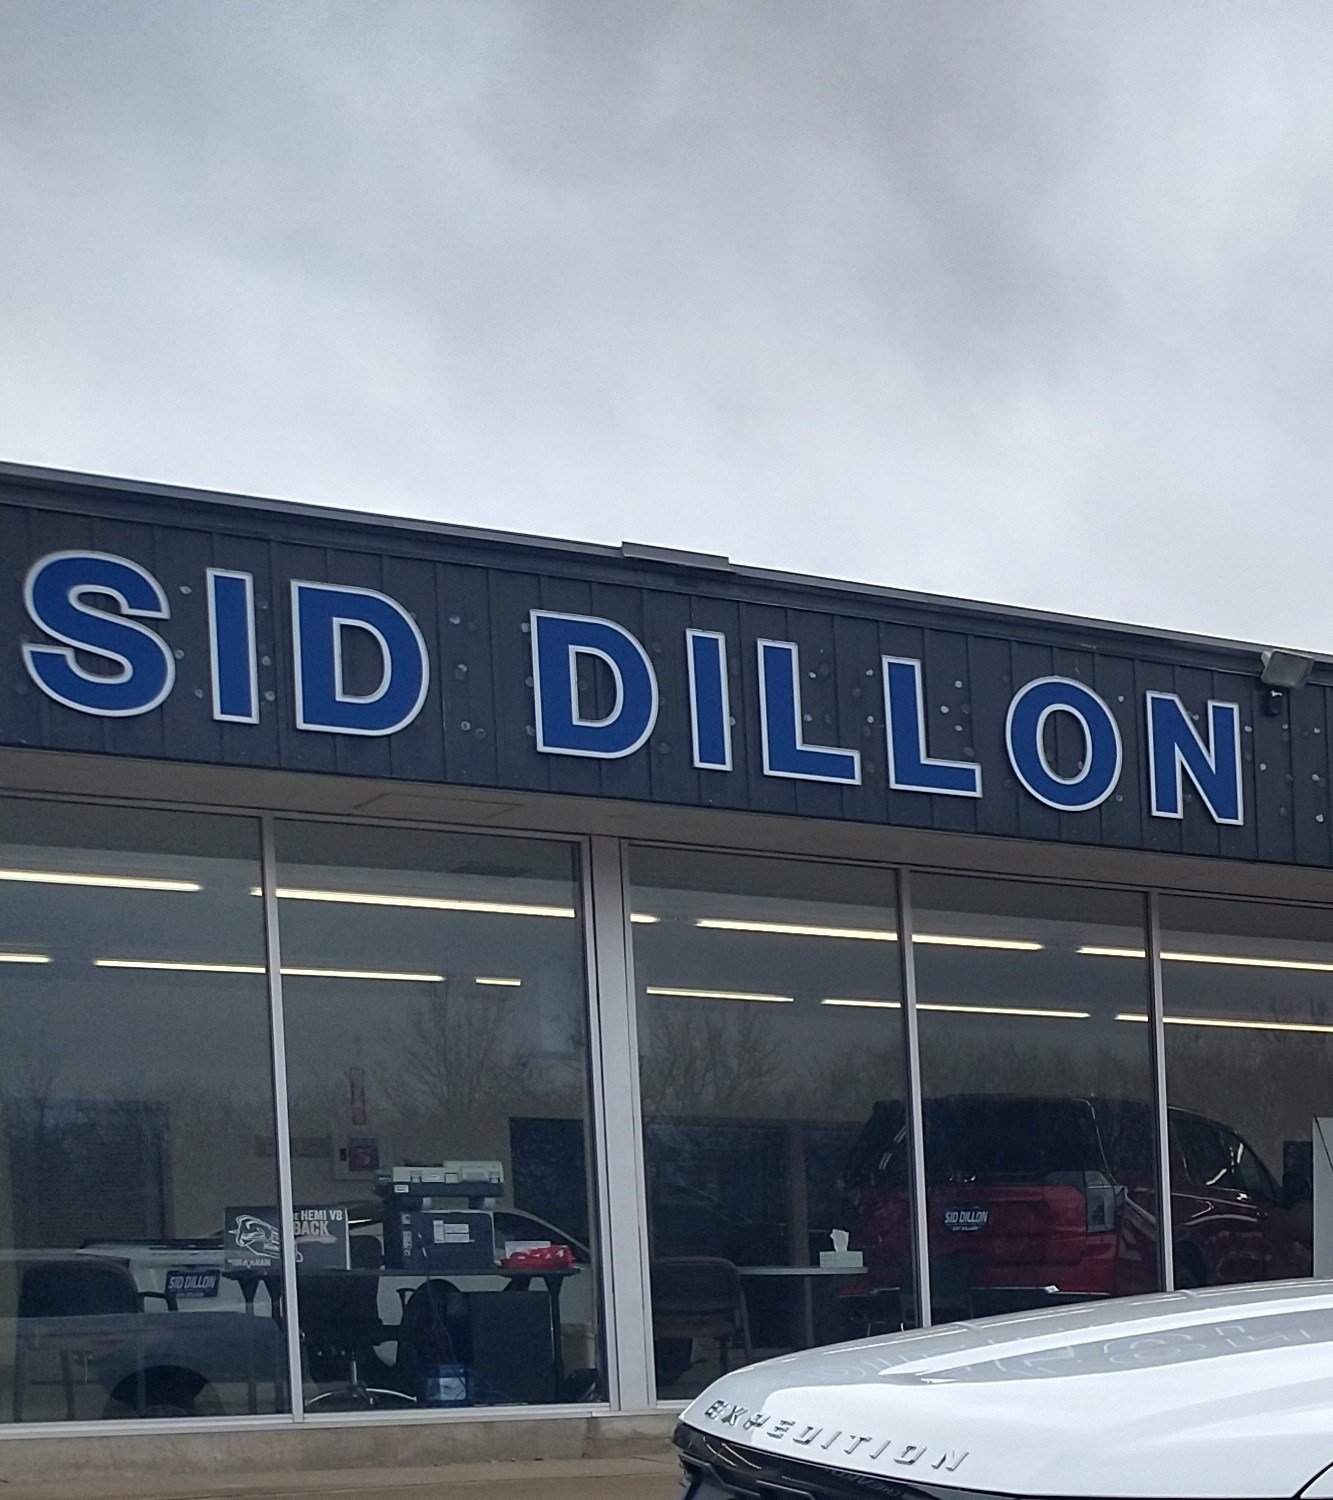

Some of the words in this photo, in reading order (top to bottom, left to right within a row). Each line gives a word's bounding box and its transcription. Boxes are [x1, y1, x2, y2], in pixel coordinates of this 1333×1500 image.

[22, 550, 429, 736] SID
[528, 608, 1244, 826] DILLON
[300, 1210, 327, 1221] HEMI
[329, 1210, 343, 1221] V8
[945, 1211, 959, 1223] SID
[959, 1211, 989, 1223] DILLON
[294, 1221, 329, 1236] BACK
[168, 1276, 184, 1289] SID
[184, 1275, 217, 1289] DILLON
[704, 1399, 970, 1472] EXPEDITION
